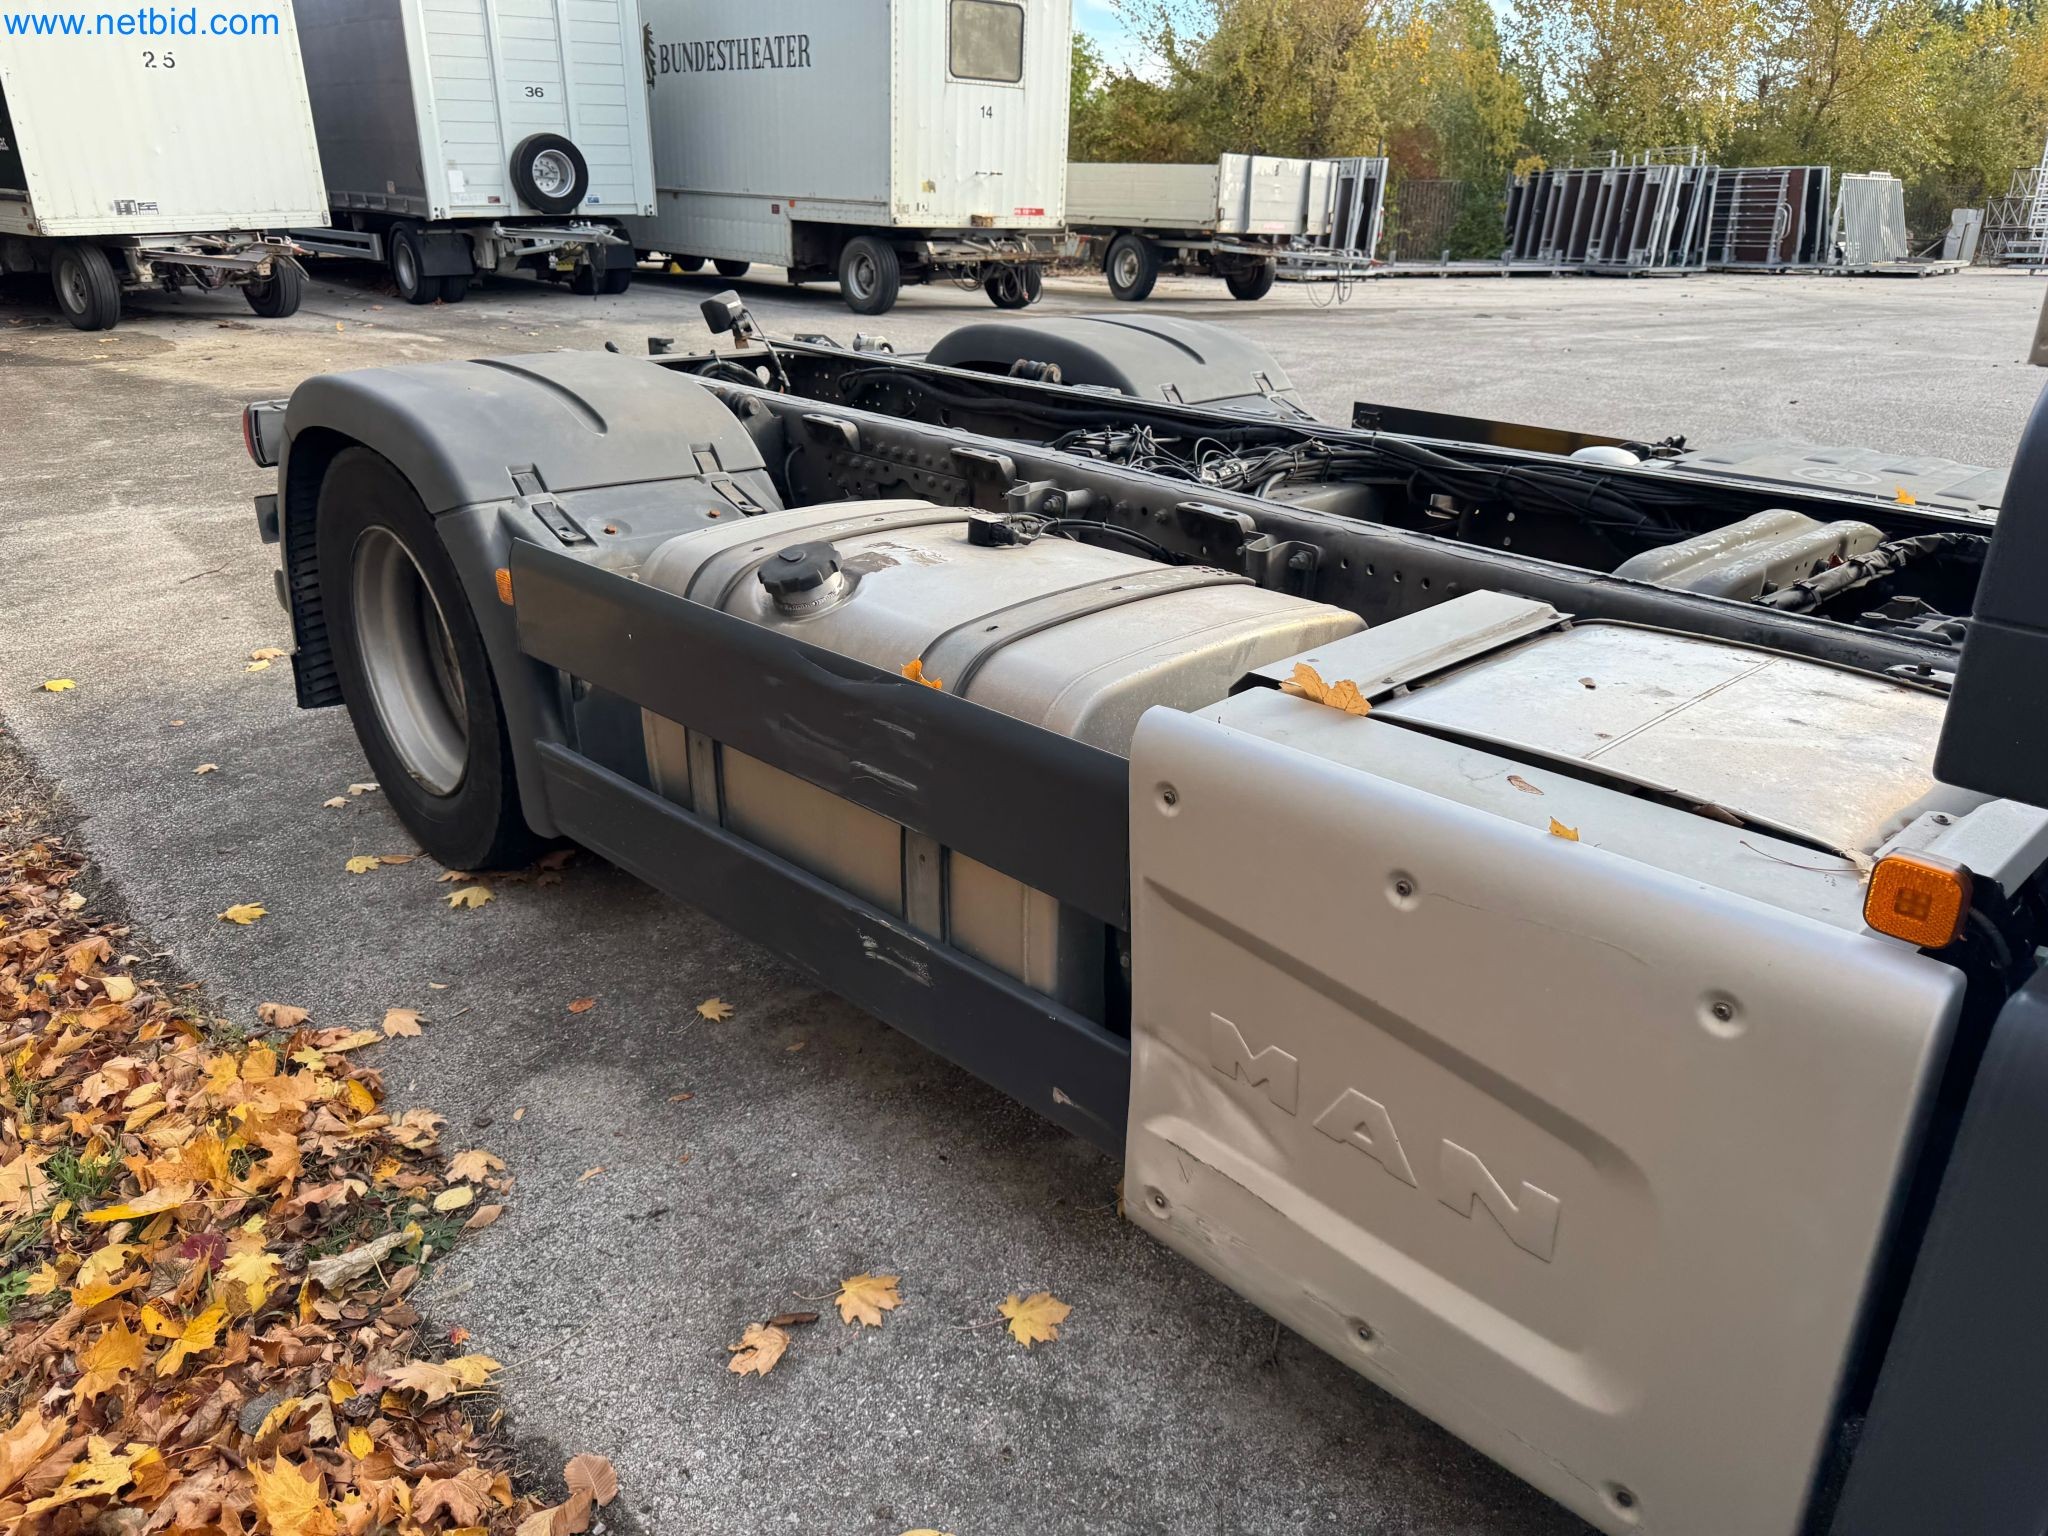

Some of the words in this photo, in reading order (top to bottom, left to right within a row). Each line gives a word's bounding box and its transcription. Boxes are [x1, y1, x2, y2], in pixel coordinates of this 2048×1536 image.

[659, 34, 811, 74] BUNDESTHEATER
[524, 86, 544, 98] 36
[980, 105, 993, 119] 14
[1209, 1012, 1561, 1263] MAN
